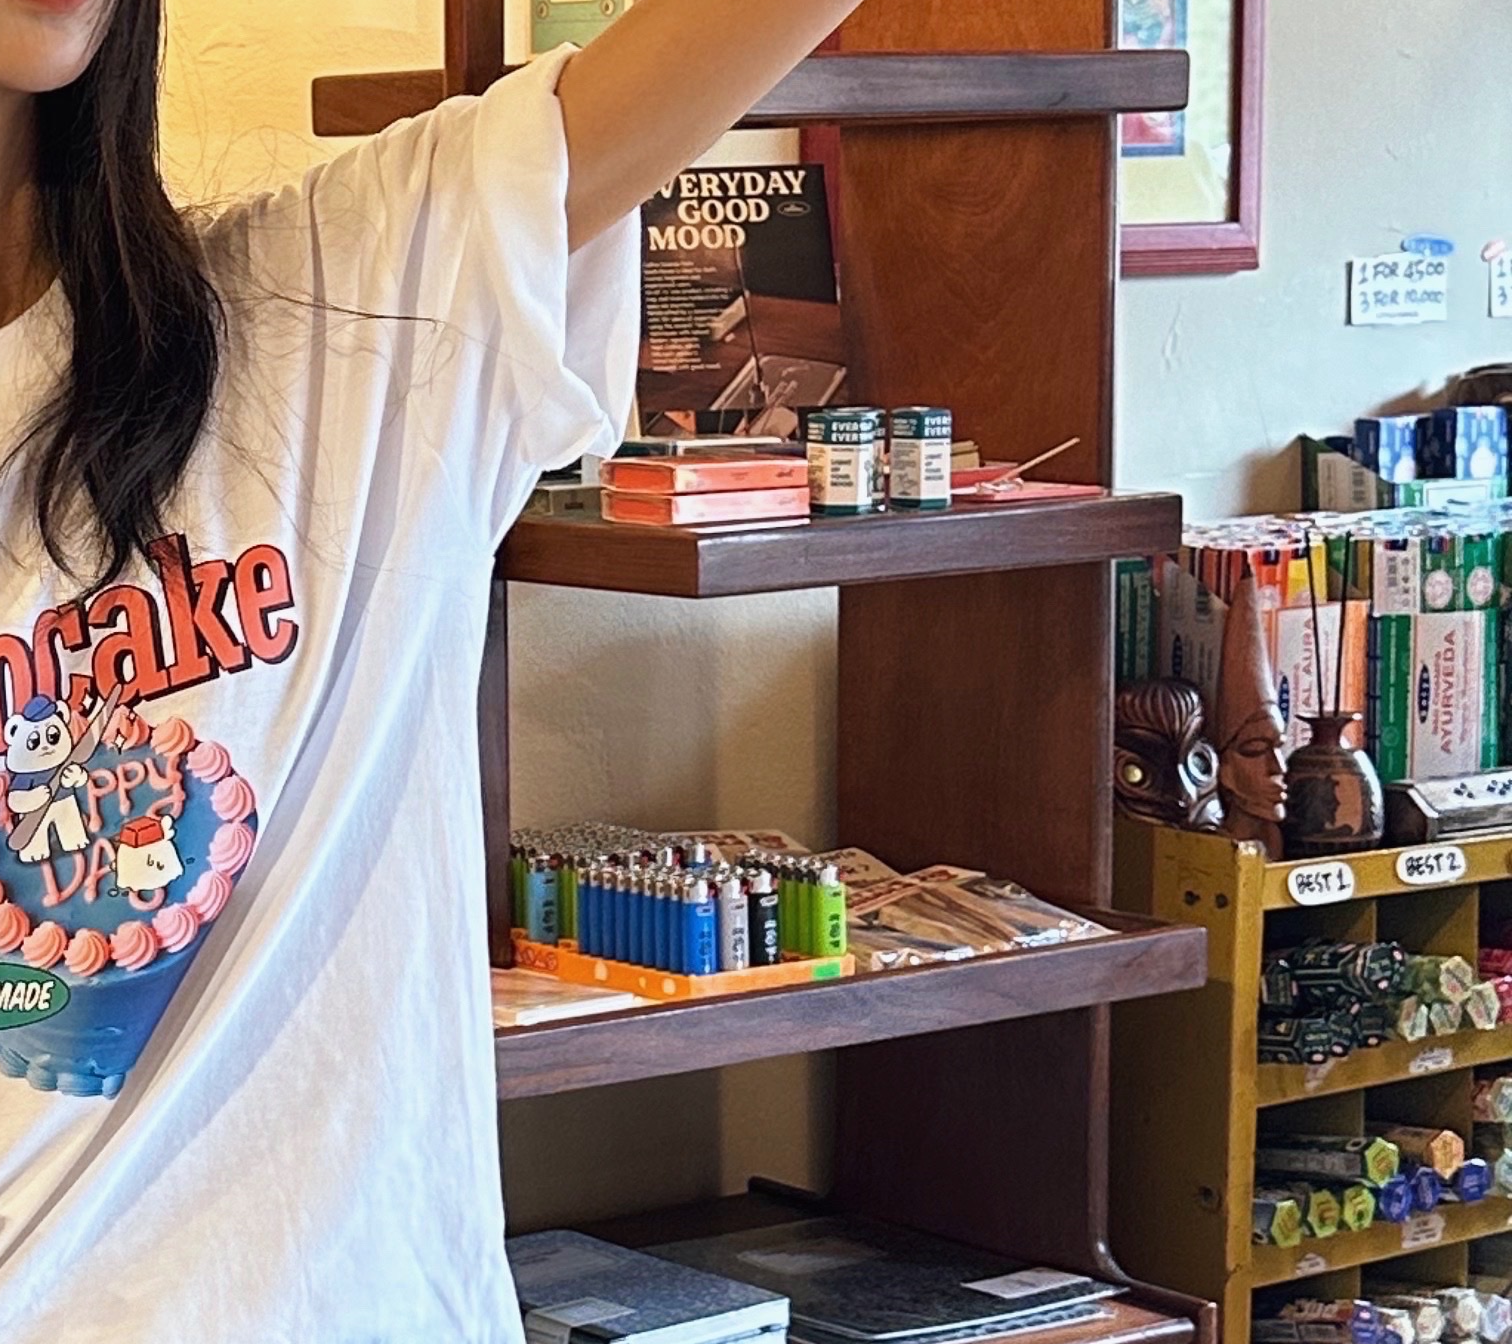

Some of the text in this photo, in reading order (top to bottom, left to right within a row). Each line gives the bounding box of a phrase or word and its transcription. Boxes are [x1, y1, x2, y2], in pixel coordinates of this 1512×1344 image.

[659, 169, 807, 200] VERYDAY
[677, 197, 771, 225] GOOD
[647, 223, 747, 251] MOOD
[1439, 629, 1456, 755] AYURVEDA
[1405, 853, 1444, 877] BEST
[1295, 870, 1332, 895] BEST
